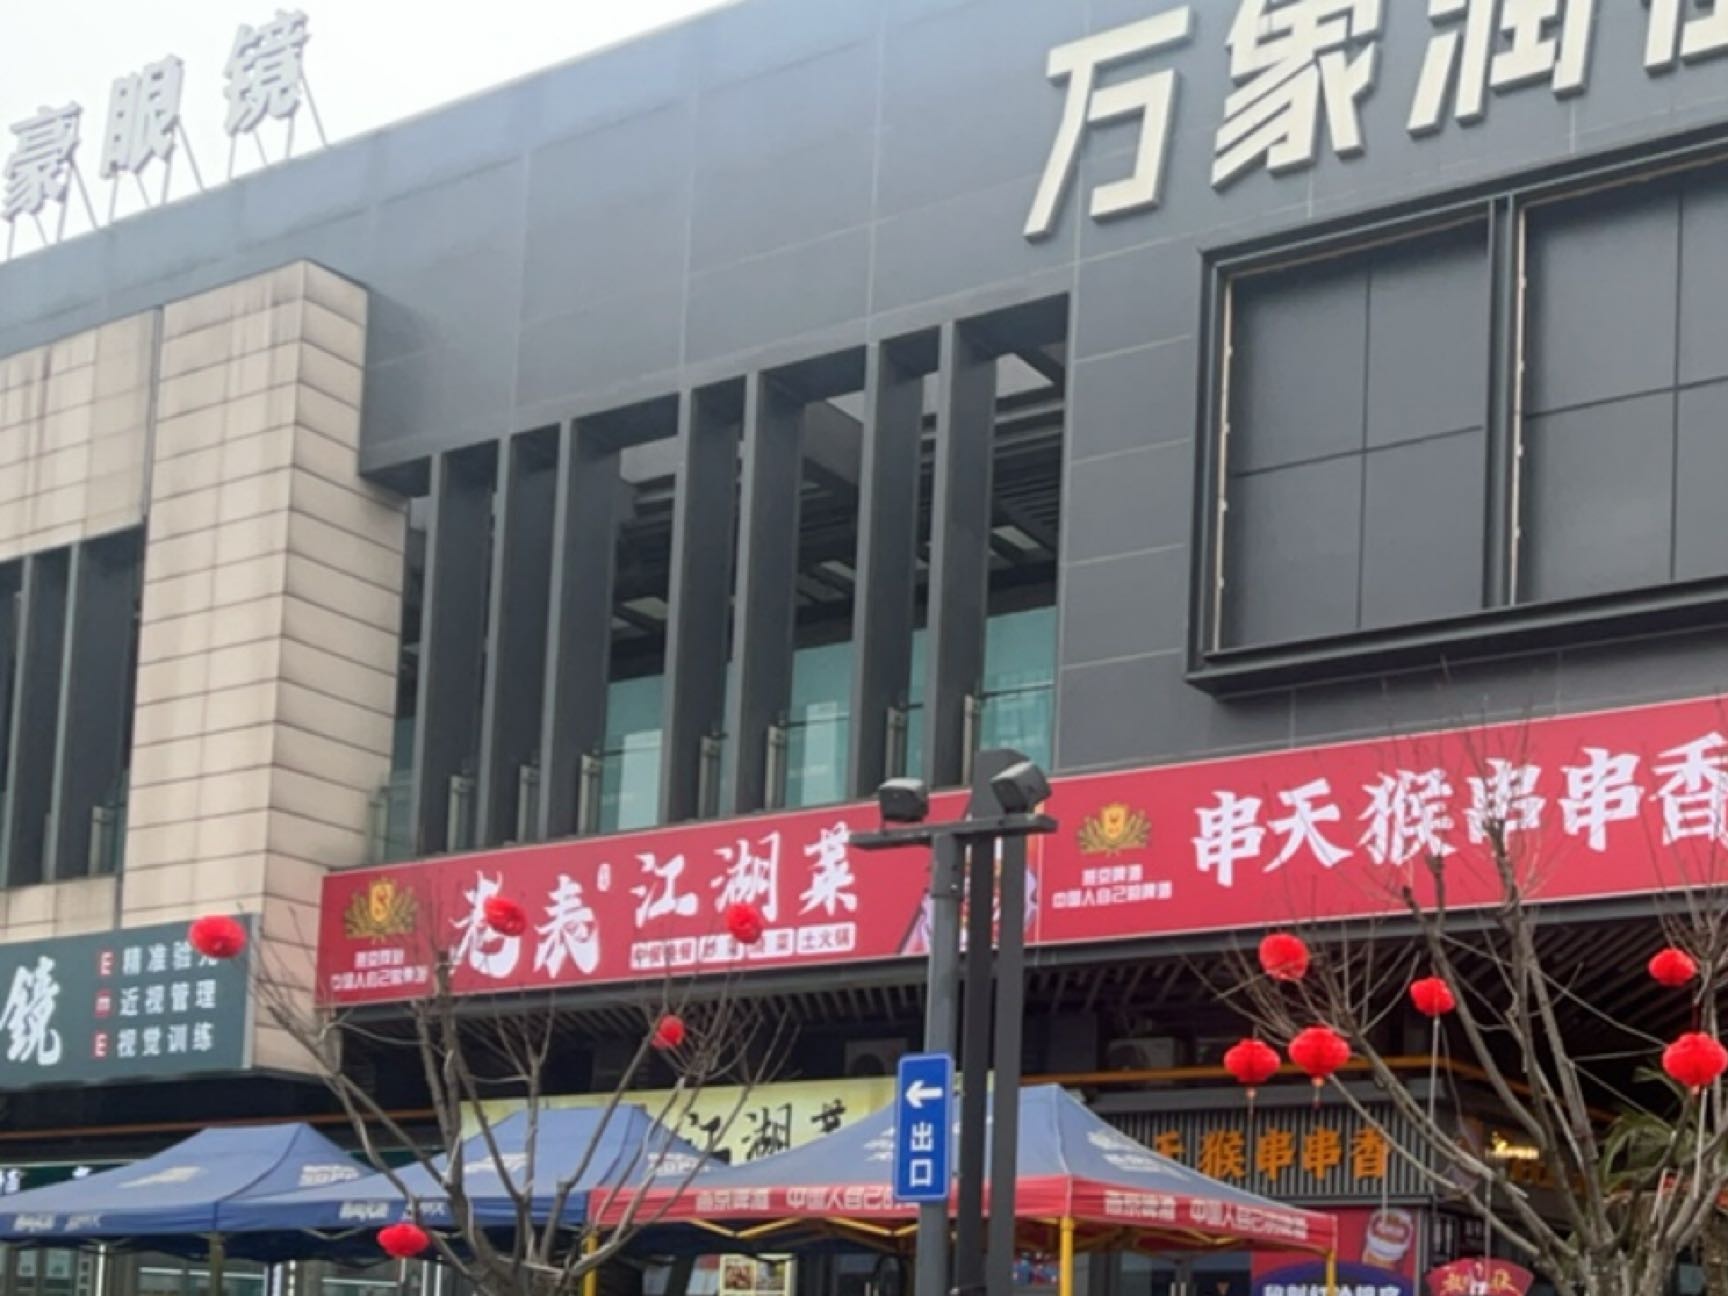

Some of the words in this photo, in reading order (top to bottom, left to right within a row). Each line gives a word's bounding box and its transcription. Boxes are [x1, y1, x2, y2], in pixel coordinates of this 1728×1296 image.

[2, 8, 309, 220] 豪眼镜
[119, 978, 217, 1017] 近视管理
[911, 1121, 934, 1188] 出口
